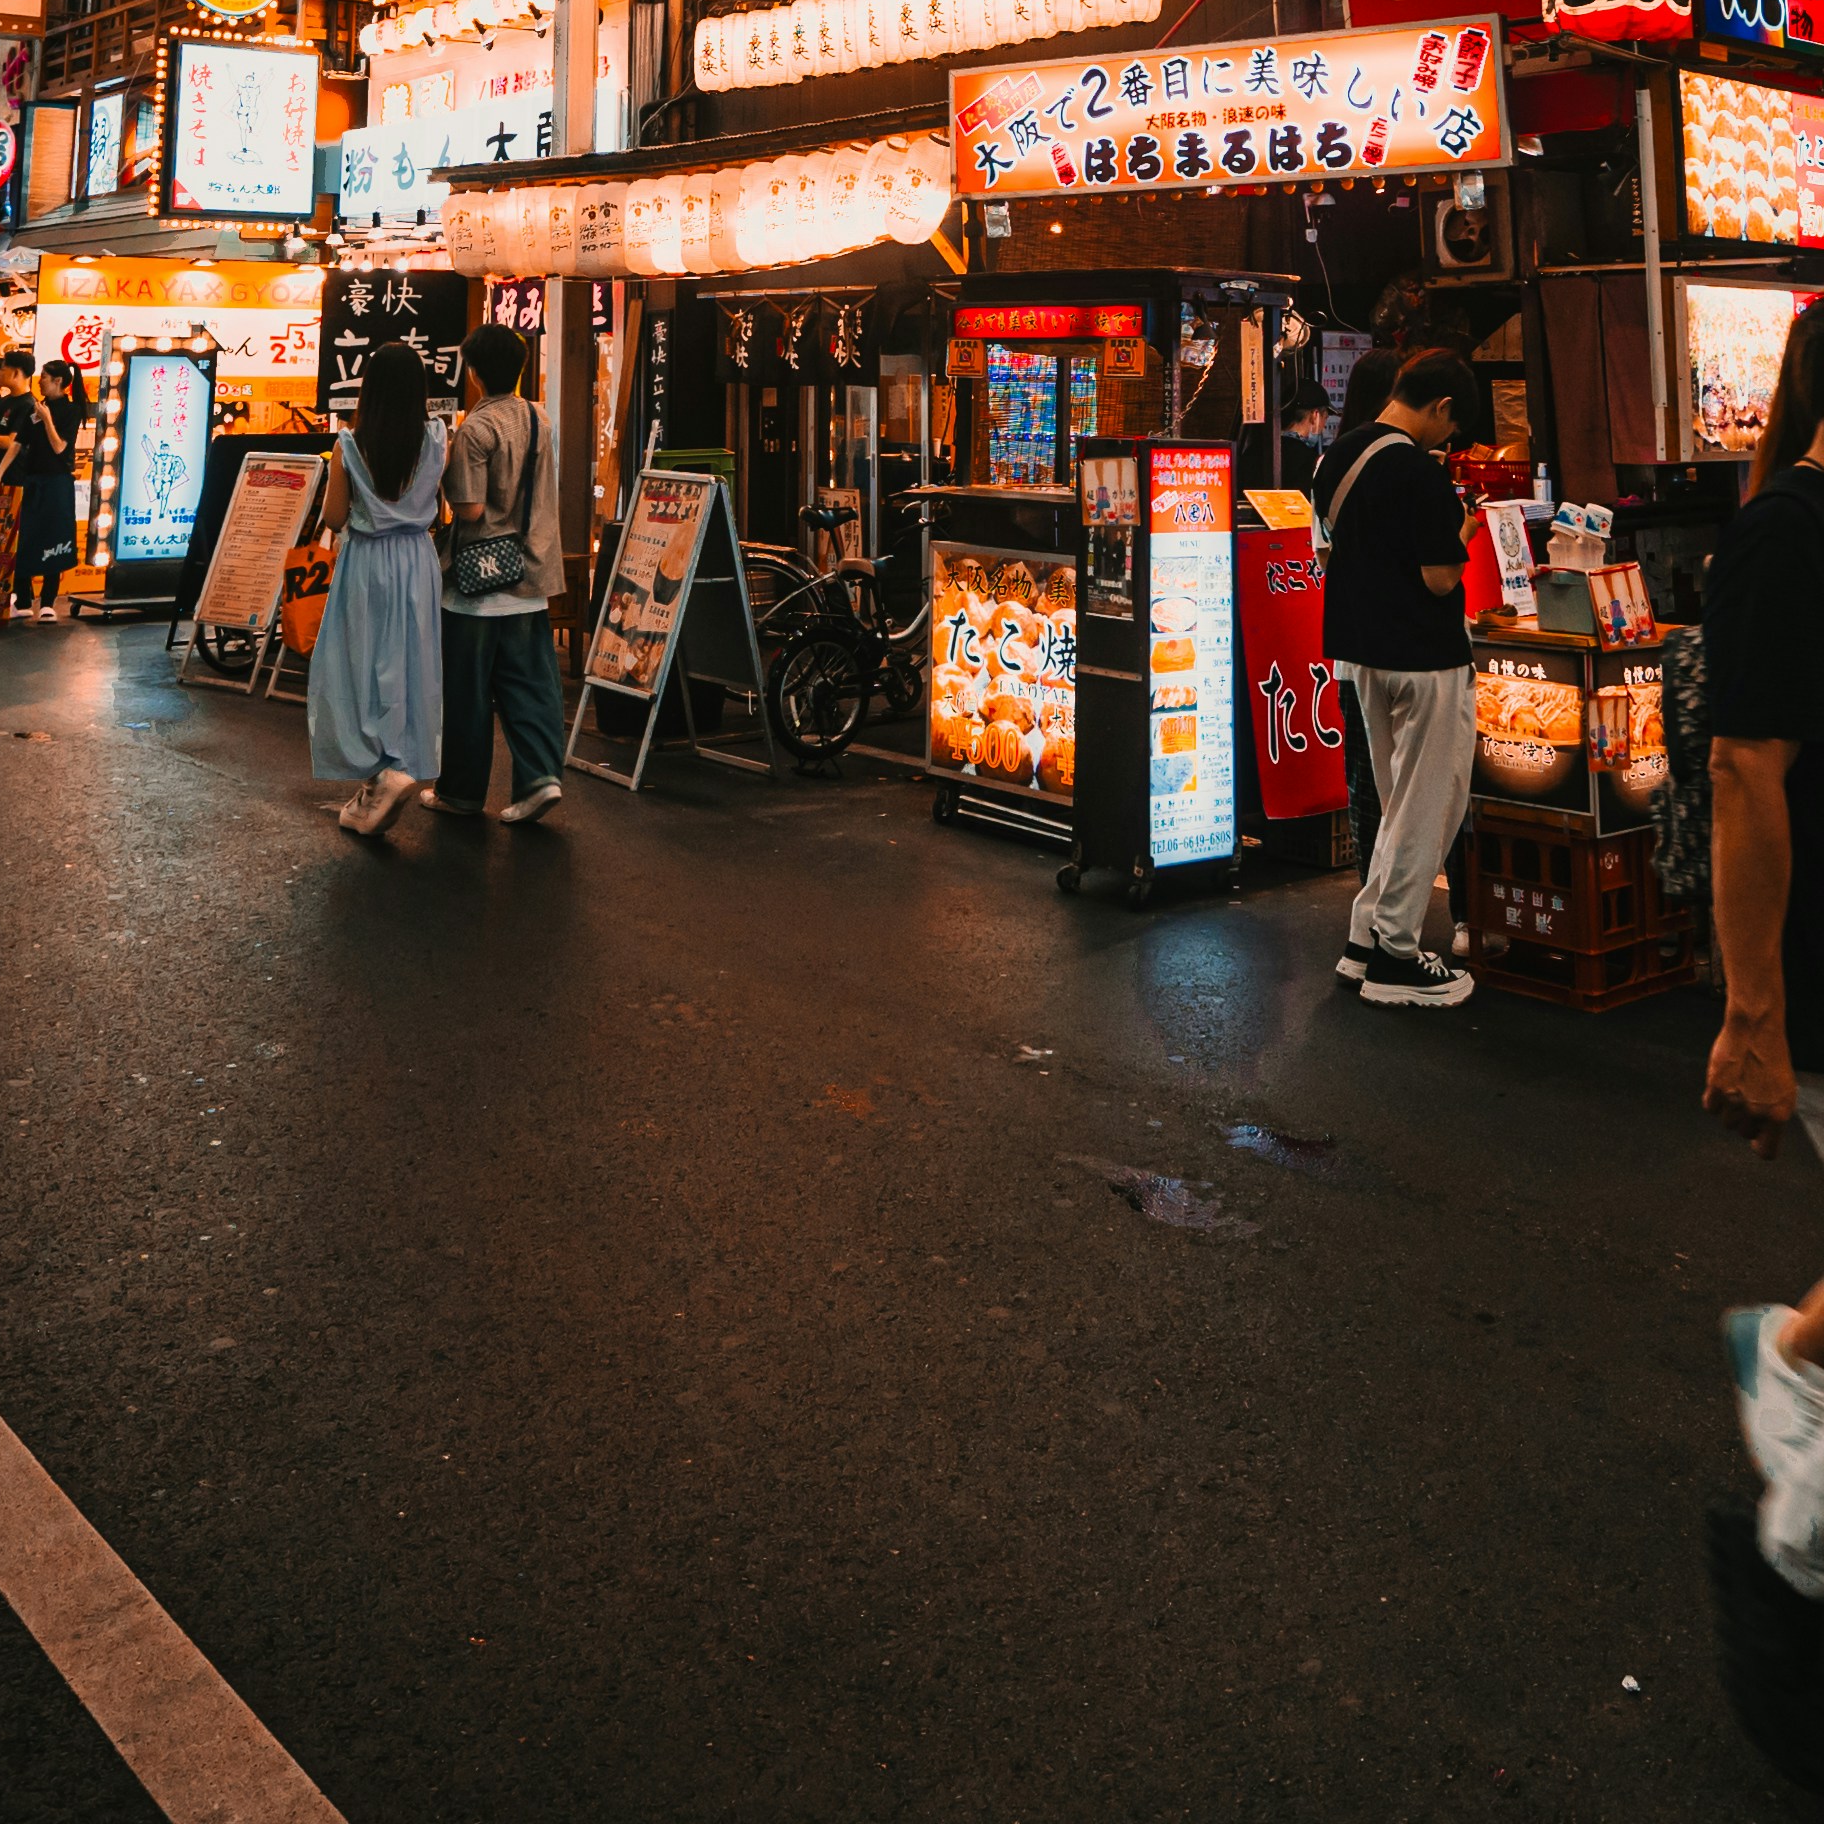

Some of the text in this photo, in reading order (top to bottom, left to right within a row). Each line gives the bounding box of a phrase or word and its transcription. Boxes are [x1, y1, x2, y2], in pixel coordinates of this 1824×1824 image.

[973, 44, 1485, 189] 大阪で2番目に美味しい店
[1083, 119, 1354, 186] はちまるはち
[60, 275, 198, 303] IZAKAYA
[341, 277, 423, 317] 豪快
[331, 328, 463, 391] 立寿司
[942, 563, 1033, 601] 大阪名物
[1487, 658, 1548, 680] 自慢の味
[1261, 660, 1343, 766] たこ
[947, 716, 1022, 773] ¥500
[1483, 735, 1557, 767] たこ焼き
